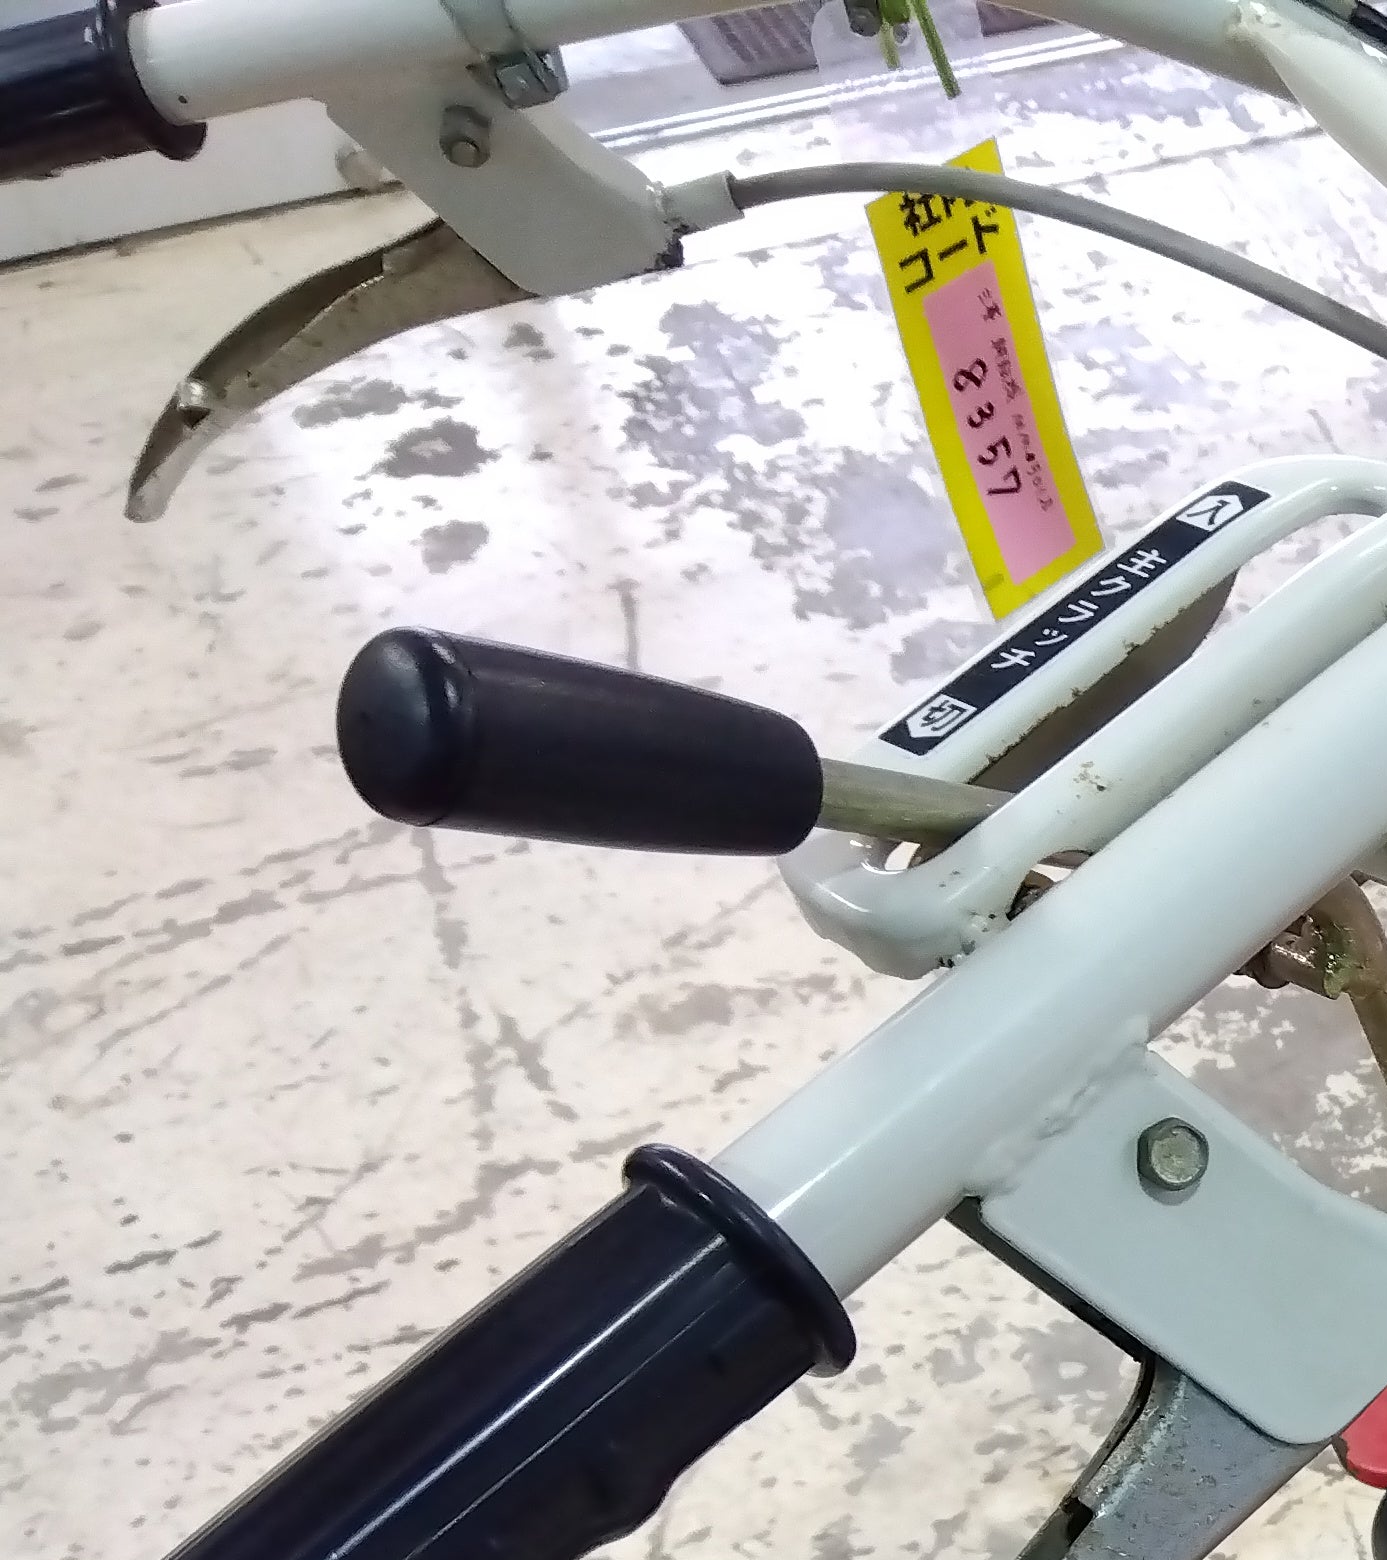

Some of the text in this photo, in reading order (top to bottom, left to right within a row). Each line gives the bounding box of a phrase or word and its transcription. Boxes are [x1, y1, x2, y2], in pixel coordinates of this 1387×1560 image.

[899, 205, 999, 294] コード
[953, 357, 1022, 497] 8357
[1187, 499, 1232, 526] 入
[990, 548, 1167, 670] 主クラッチ
